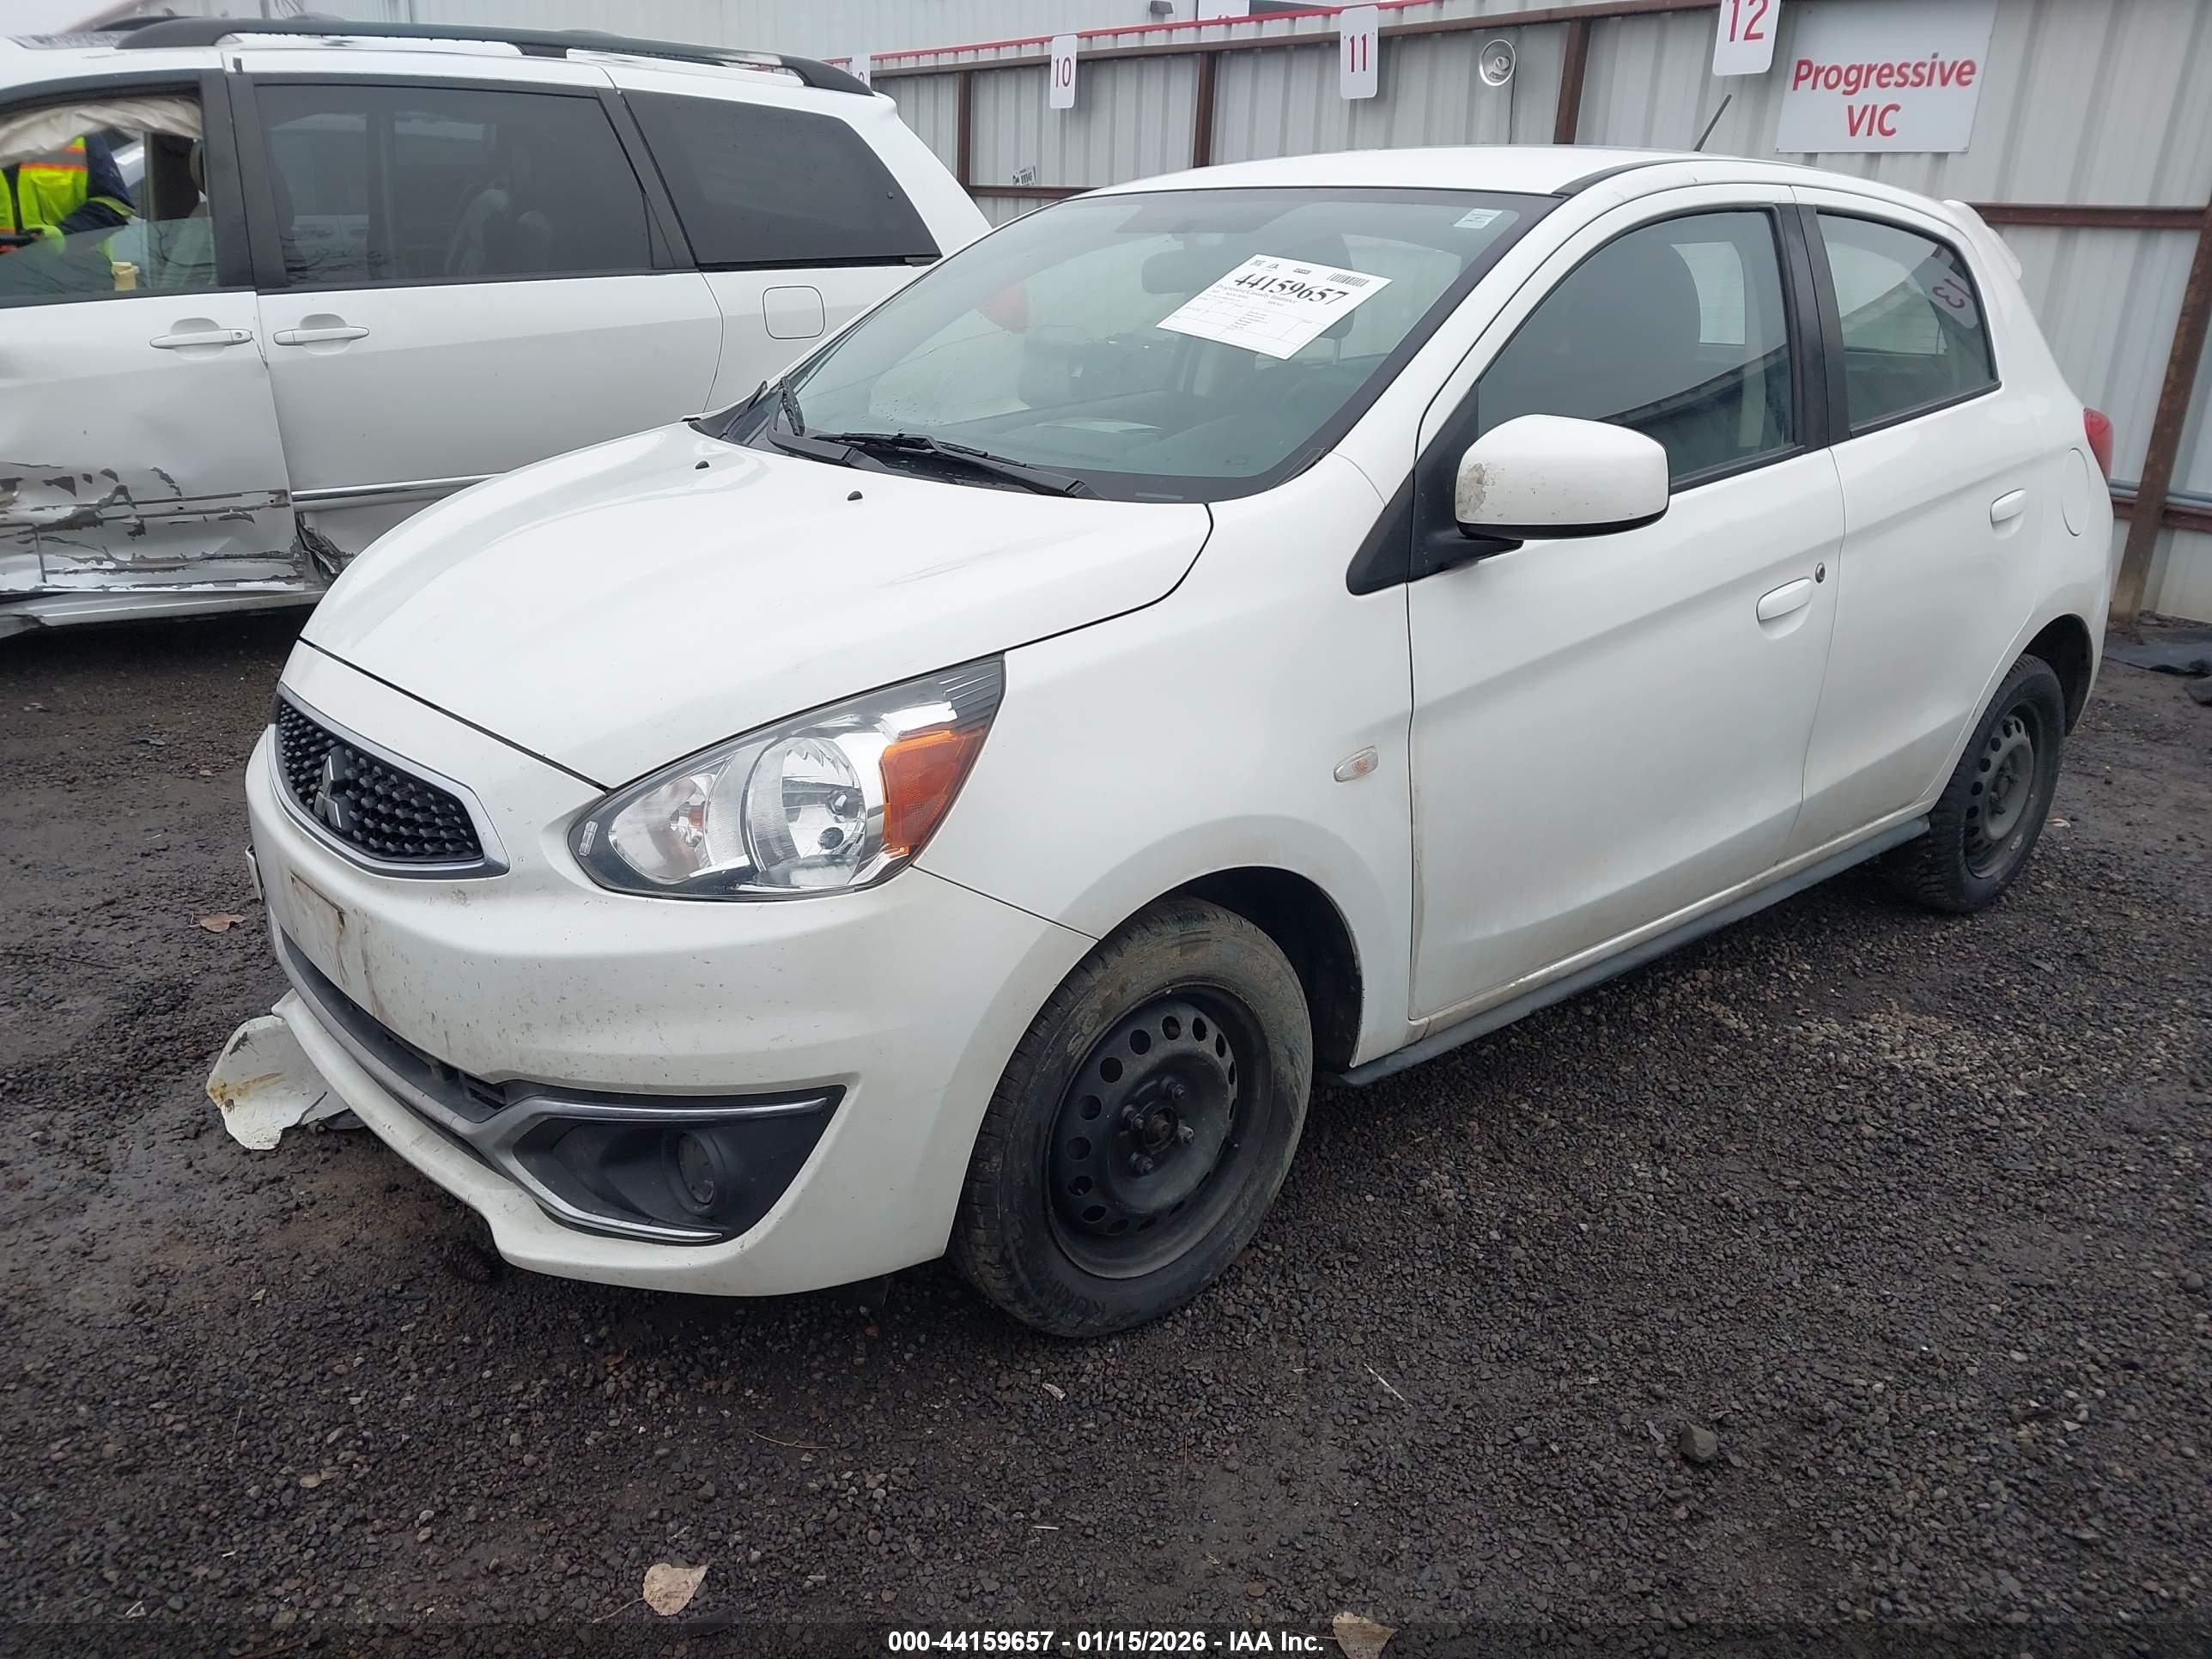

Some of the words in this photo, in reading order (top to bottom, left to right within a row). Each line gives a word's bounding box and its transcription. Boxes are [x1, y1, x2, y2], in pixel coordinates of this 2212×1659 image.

[1728, 0, 1769, 42] 12
[1349, 33, 1367, 73] 11
[1055, 57, 1072, 88] 10
[1792, 52, 1977, 96] Progressive
[1846, 103, 1901, 137] VIC
[1234, 272, 1350, 306] 44159657
